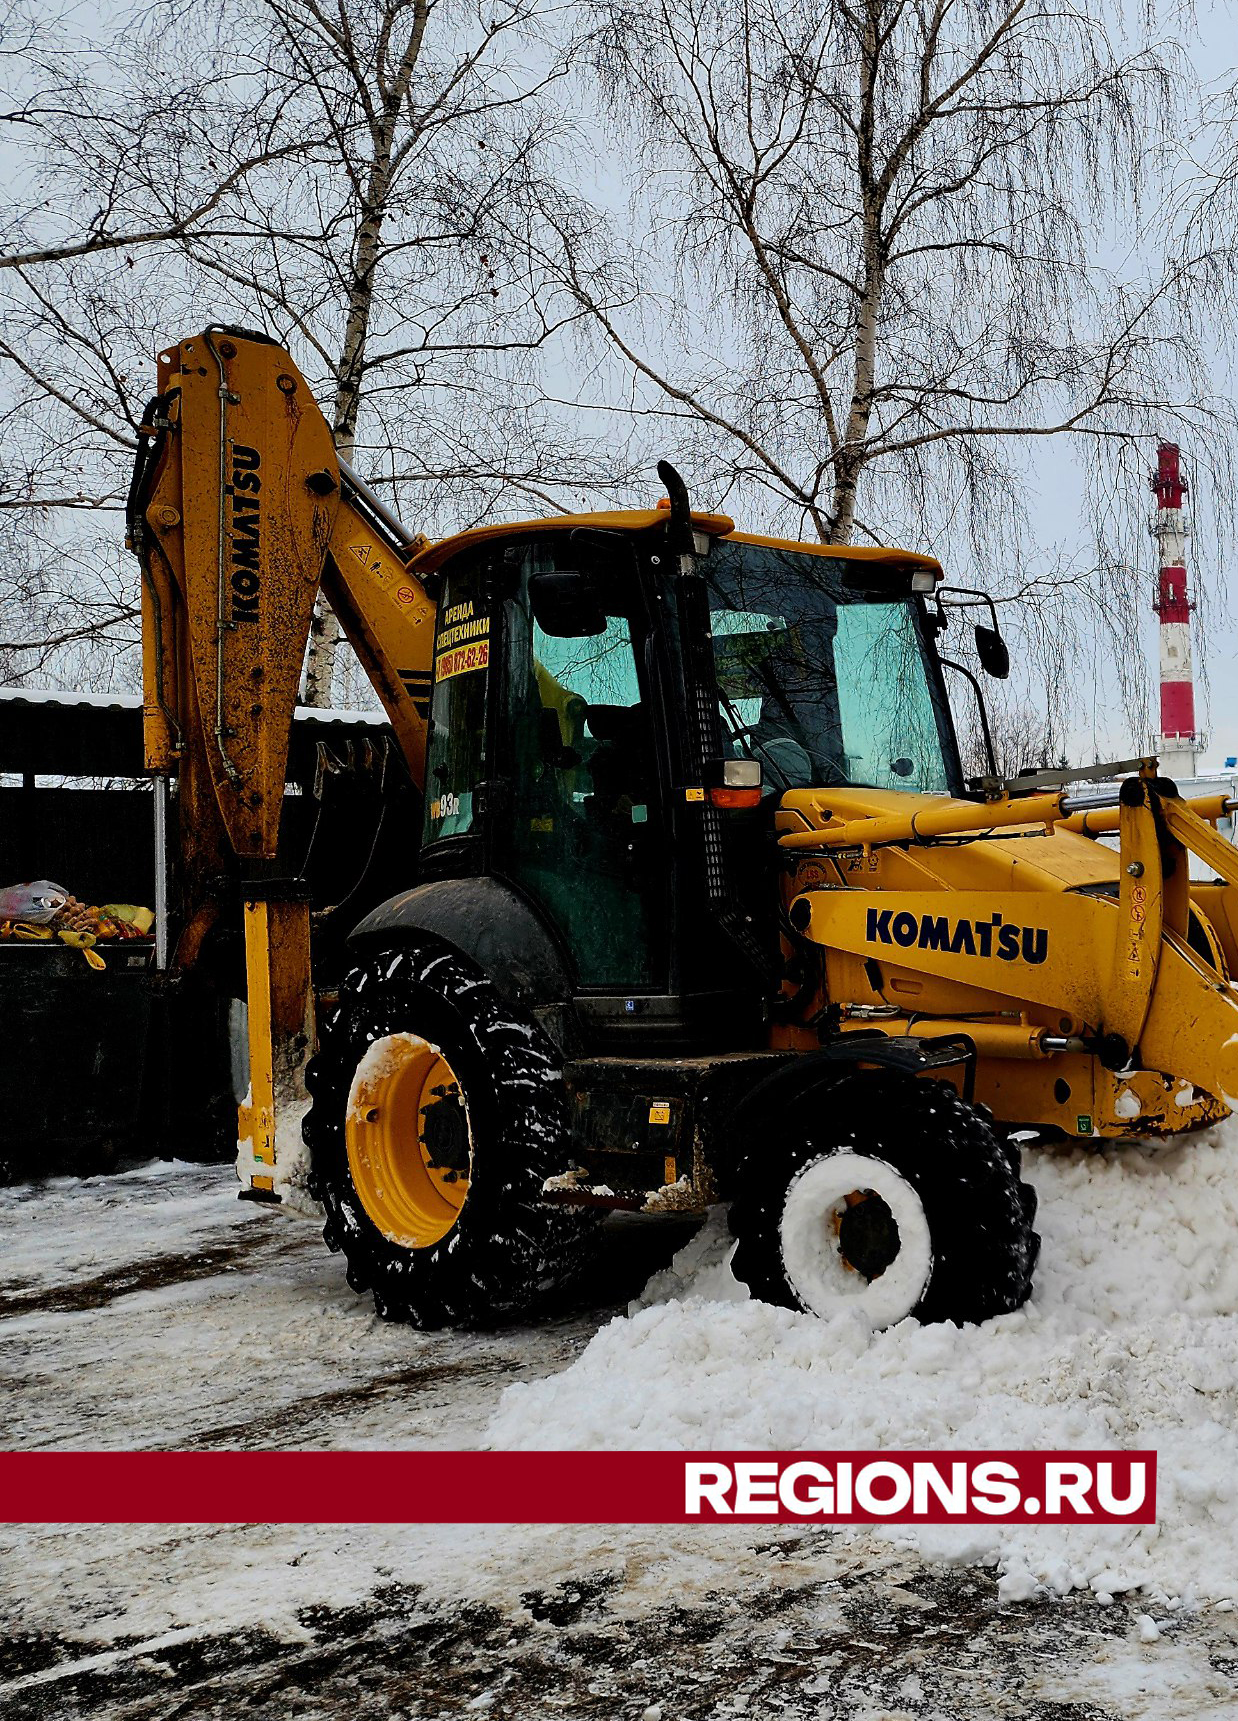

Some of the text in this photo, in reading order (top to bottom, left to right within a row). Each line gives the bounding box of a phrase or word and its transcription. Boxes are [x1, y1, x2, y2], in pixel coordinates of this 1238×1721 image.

[231, 444, 261, 623] KOMATSU
[436, 616, 490, 651] СПЕЦТЕХНИКИ
[444, 600, 474, 626] АРЕНДА
[866, 907, 1048, 965] KOMATSU
